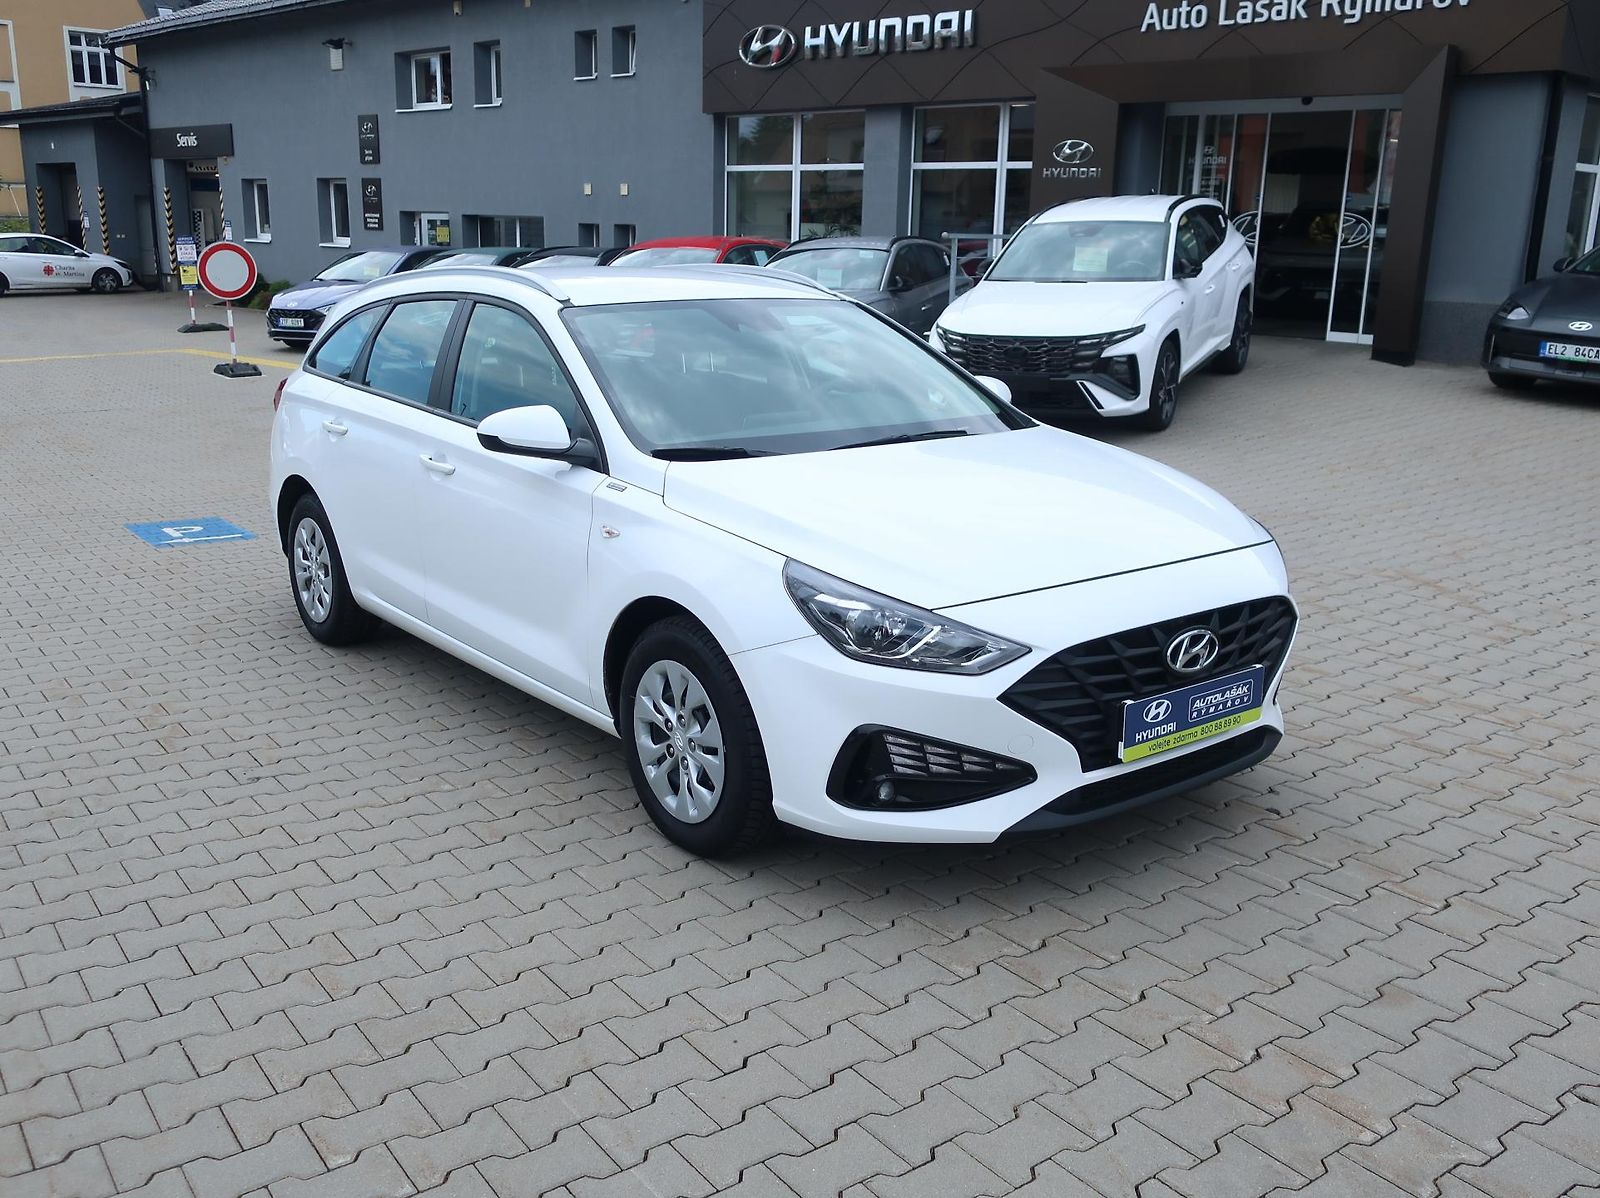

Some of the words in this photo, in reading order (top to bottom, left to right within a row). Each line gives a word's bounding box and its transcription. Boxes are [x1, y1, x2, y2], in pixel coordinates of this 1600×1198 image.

[1140, 1, 1208, 32] Auto
[804, 9, 974, 60] HYUNDAI
[176, 132, 198, 147] Servis
[1042, 167, 1103, 178] HYUNDAI
[1548, 344, 1567, 356] EL2
[1575, 347, 1600, 359] 84CA
[161, 526, 204, 538] P
[1191, 695, 1249, 719] RÝMAŘOV
[1192, 684, 1250, 709] AUTOLAŠÁK
[1135, 721, 1177, 743] HYUNDAI
[1148, 737, 1171, 752] volejte
[1173, 731, 1198, 745] zdarma
[1200, 724, 1213, 736] 800
[1232, 715, 1241, 726] 90
